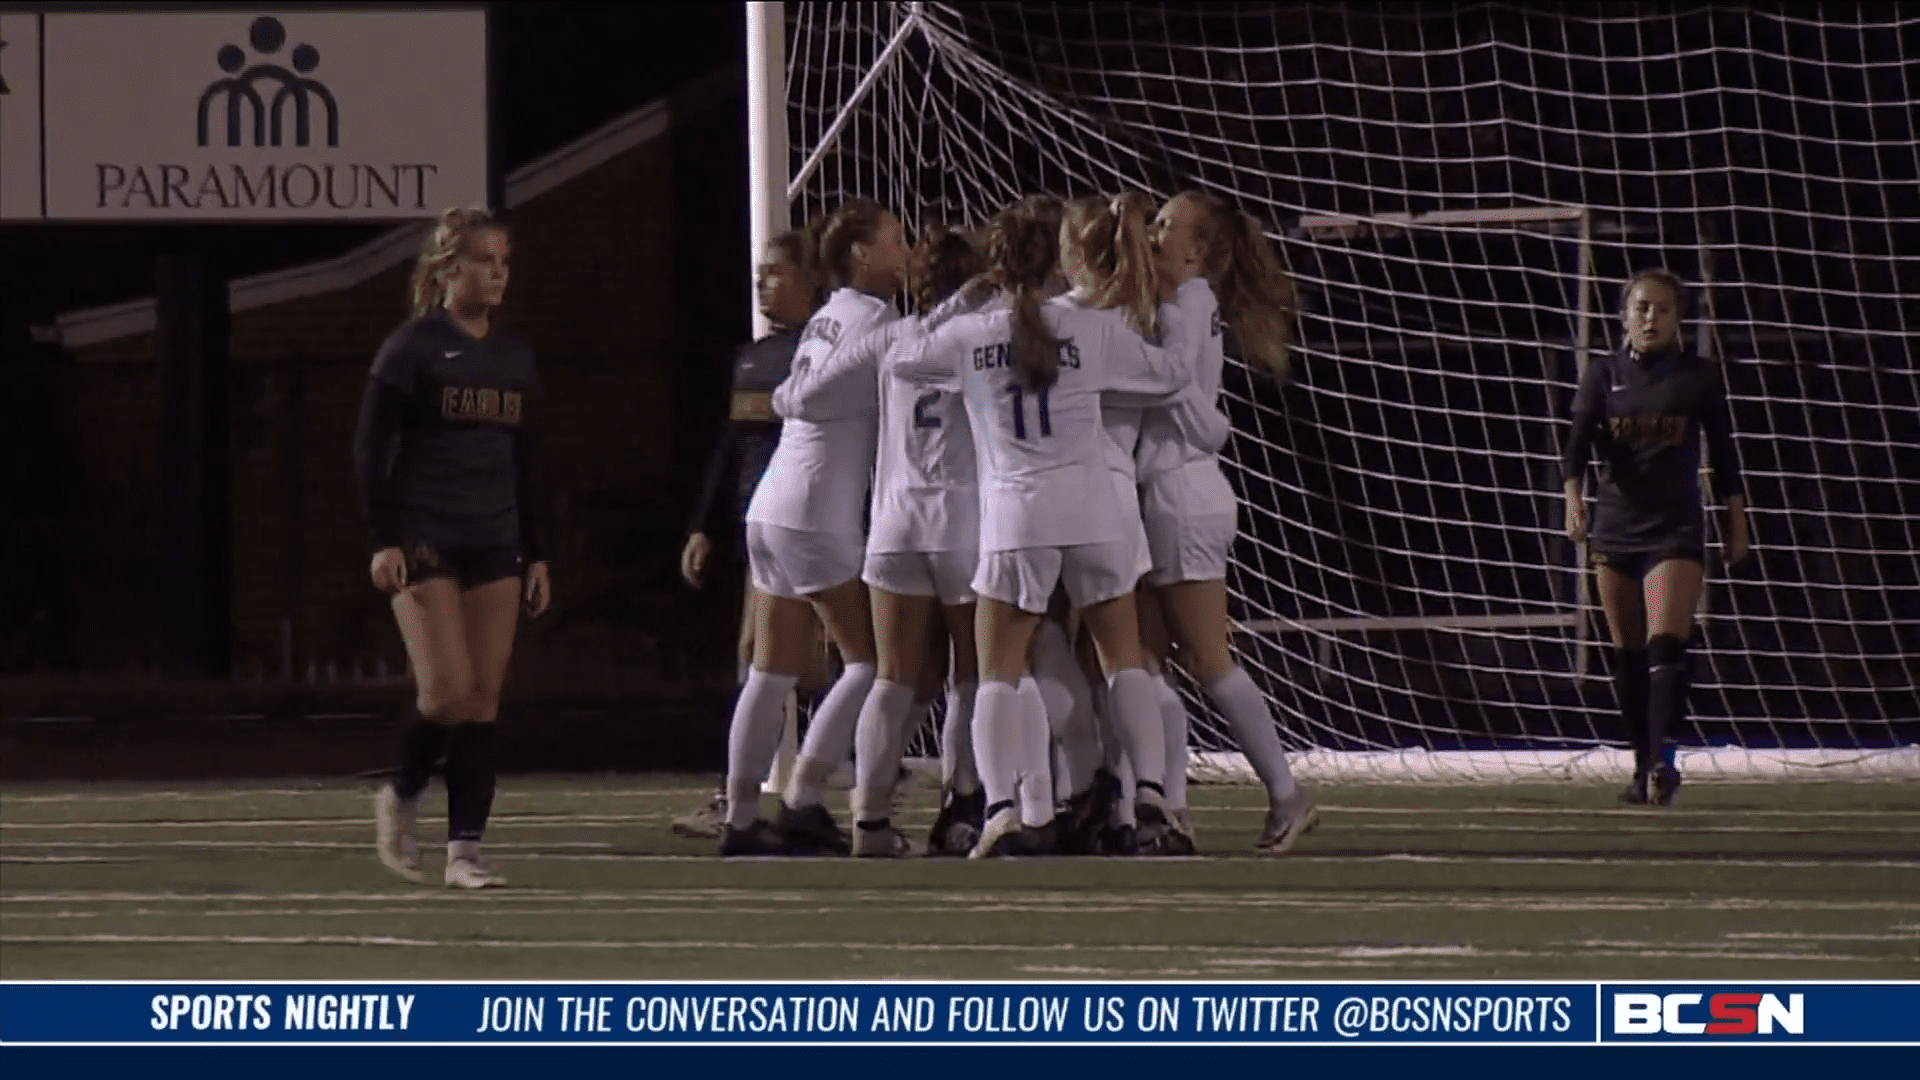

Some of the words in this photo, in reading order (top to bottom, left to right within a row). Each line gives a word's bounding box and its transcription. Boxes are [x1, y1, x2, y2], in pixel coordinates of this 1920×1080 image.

[95, 163, 438, 210] PARAMOUNT
[973, 343, 1080, 371] GENLS
[1006, 383, 1050, 440] 11
